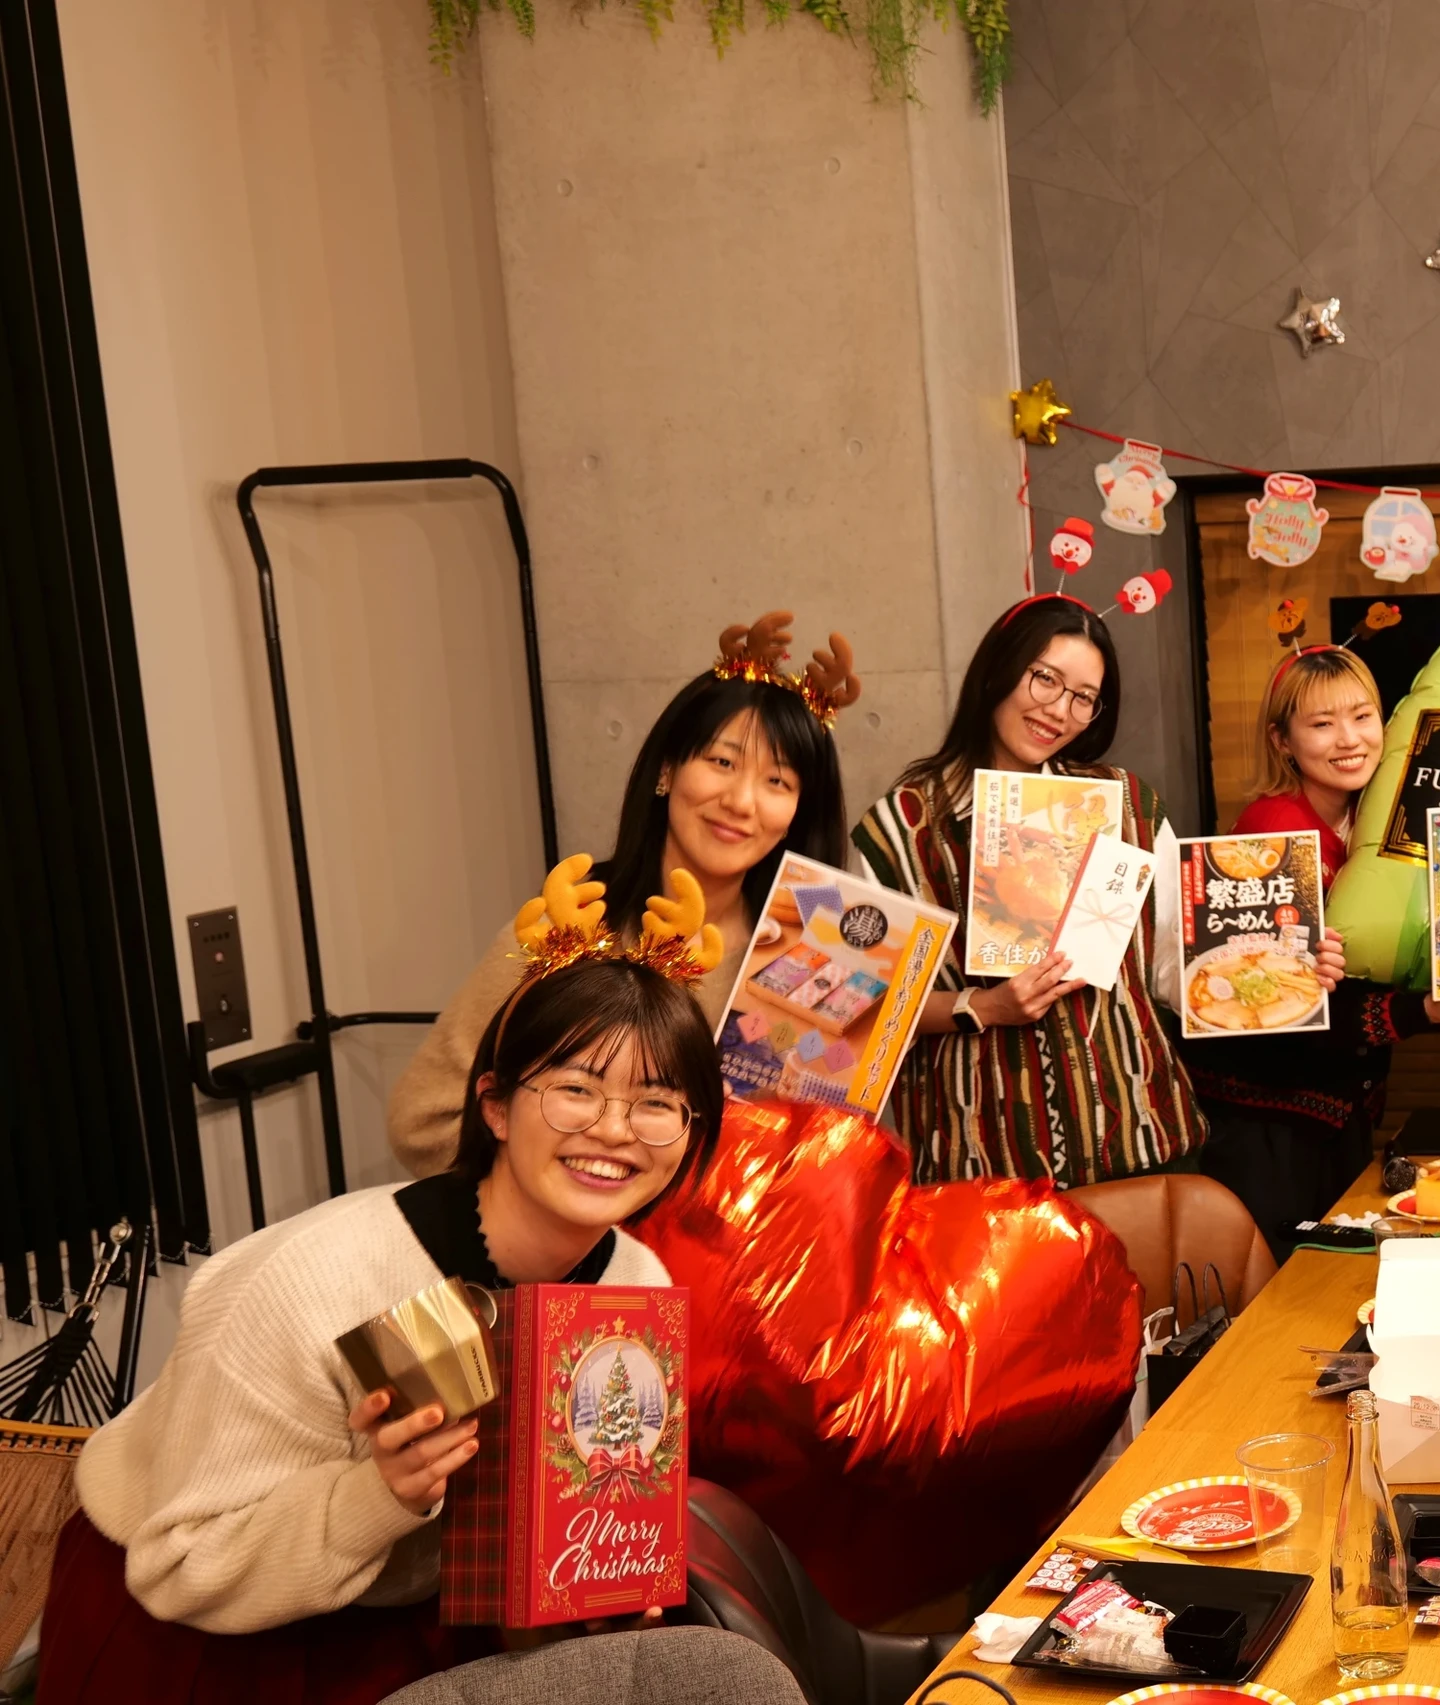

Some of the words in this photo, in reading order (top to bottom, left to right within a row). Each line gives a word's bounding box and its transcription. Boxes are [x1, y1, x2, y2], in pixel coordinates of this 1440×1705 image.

[1105, 861, 1128, 895] 目録
[1206, 874, 1295, 911] 繁盛店
[470, 1344, 490, 1398] STARBUCKS
[565, 1507, 664, 1559] Merry
[548, 1542, 668, 1591] Christmas
